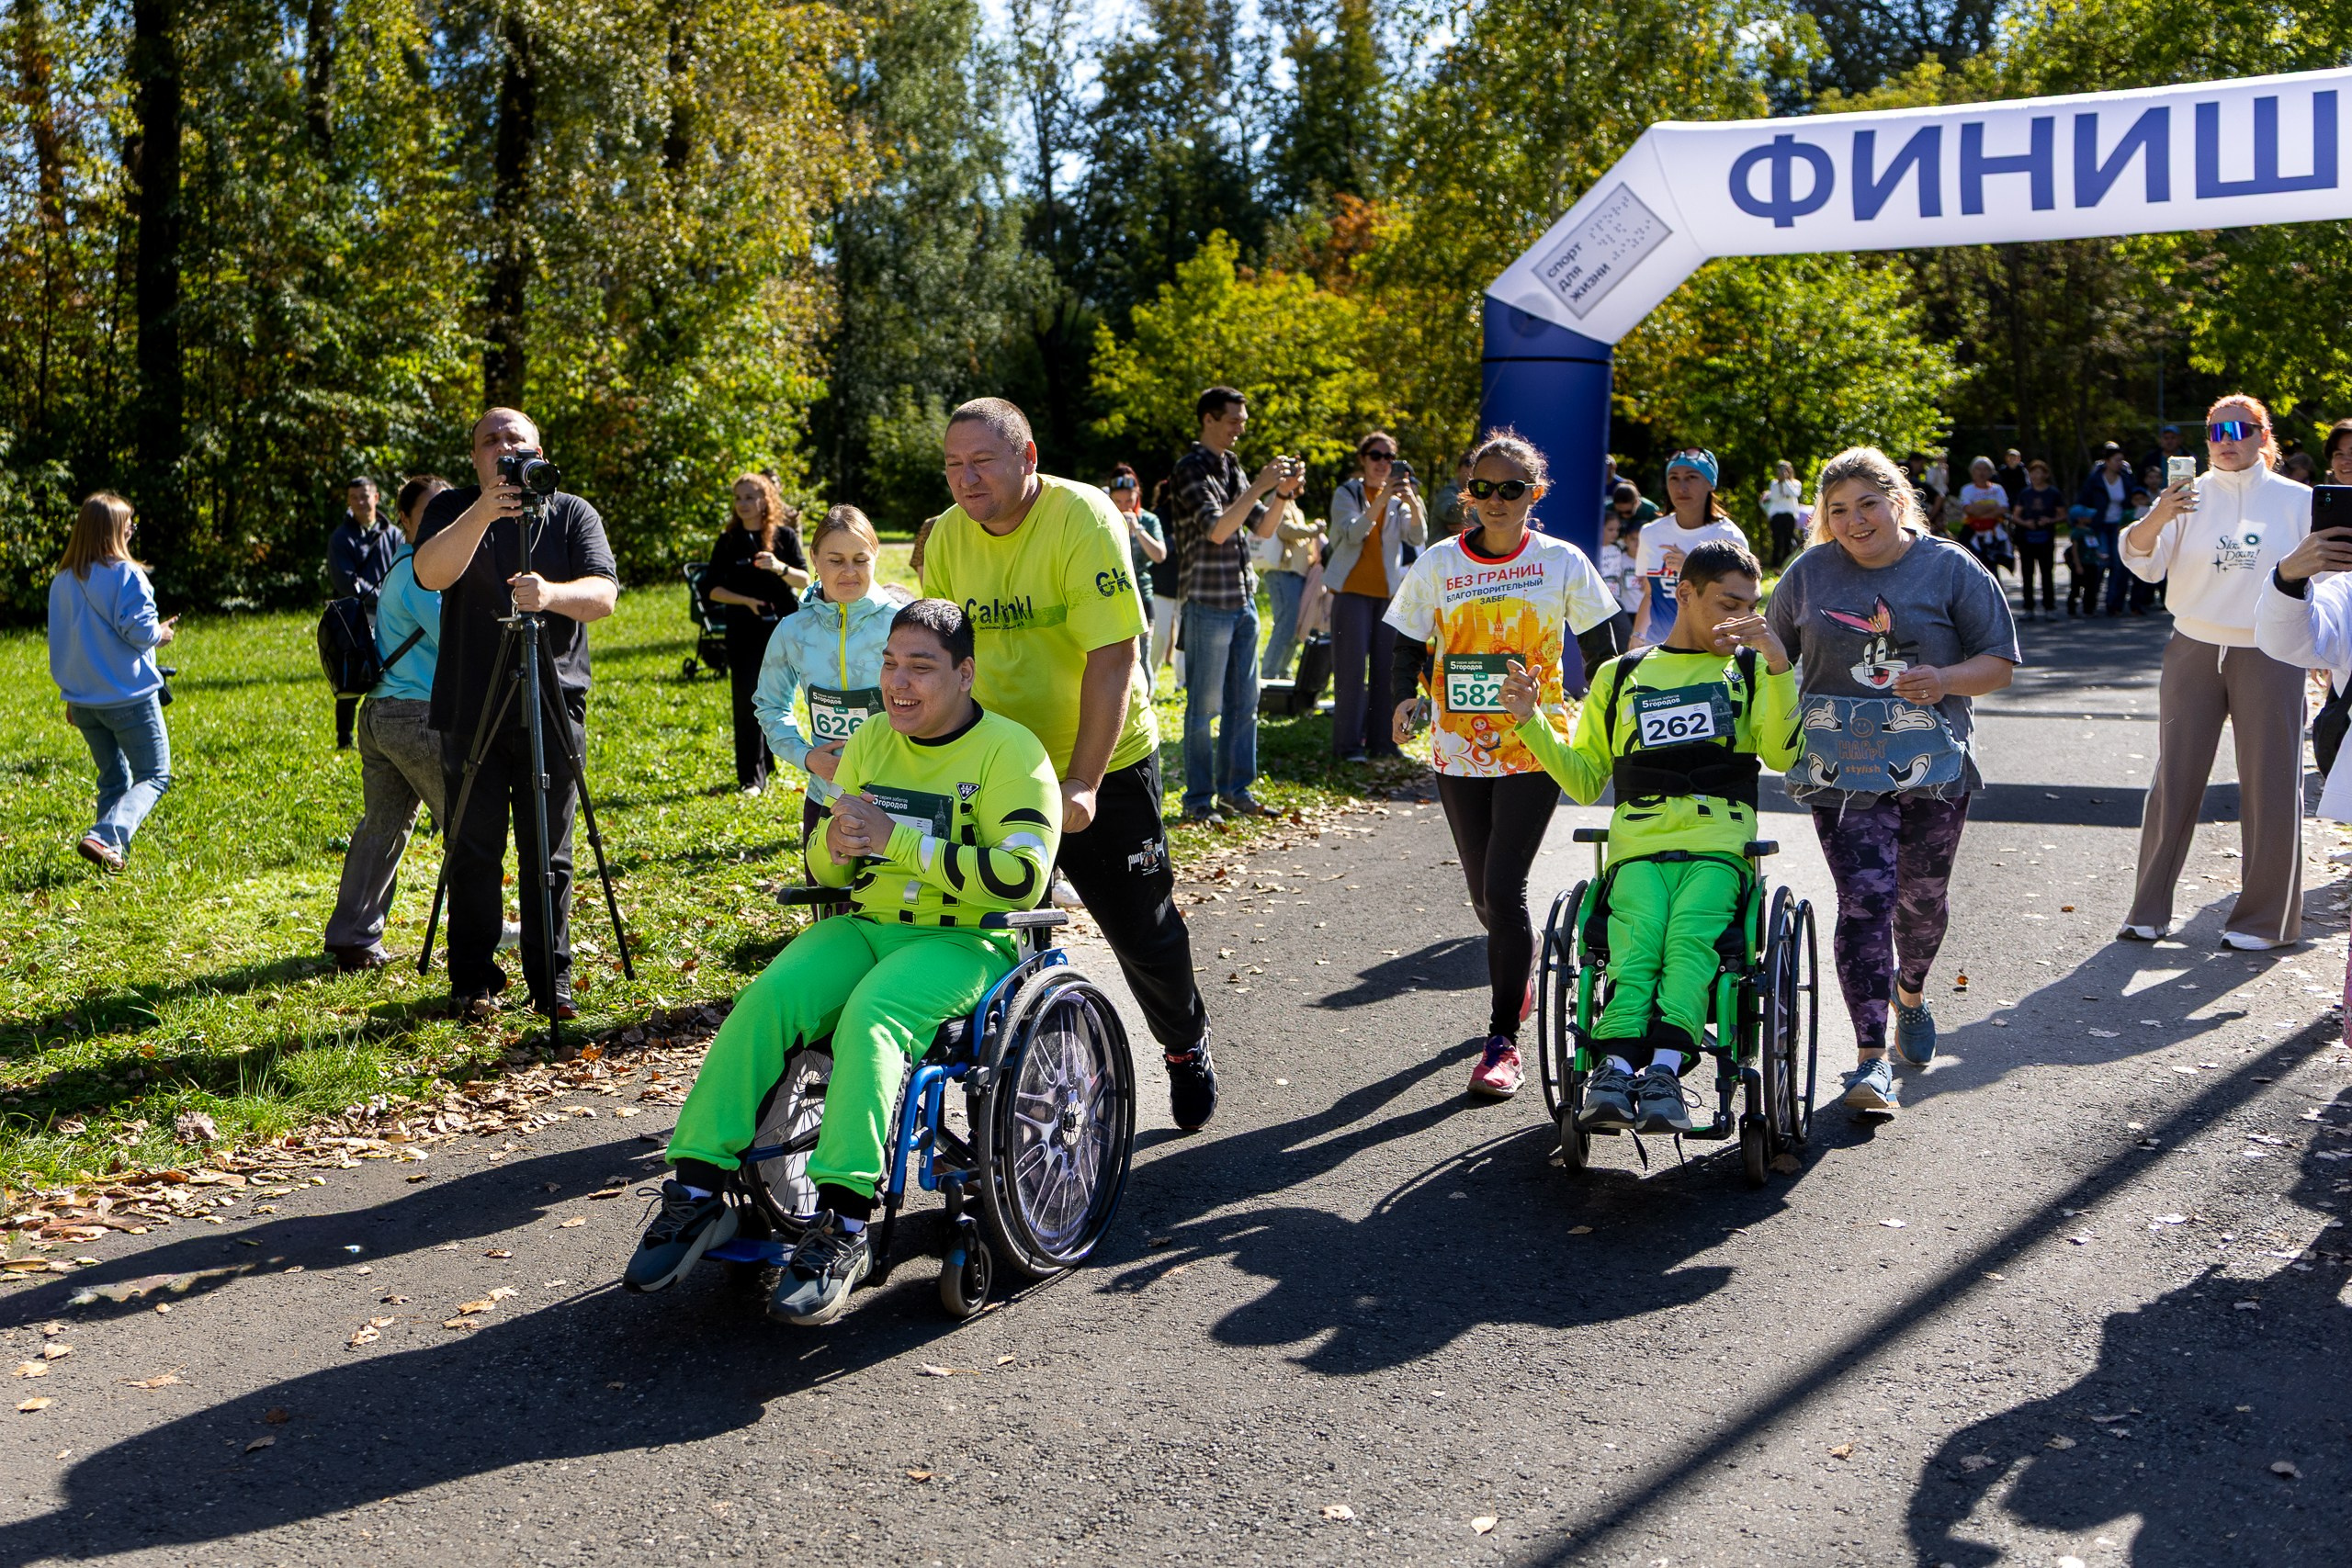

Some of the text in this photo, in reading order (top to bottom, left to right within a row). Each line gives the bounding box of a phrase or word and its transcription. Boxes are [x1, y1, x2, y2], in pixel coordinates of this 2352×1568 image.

[1728, 89, 2339, 228] ФИНИШ
[1547, 242, 1583, 277] спорт
[1558, 265, 1583, 292] для
[1570, 263, 1611, 303] жизни
[1446, 563, 1544, 591] БЕЗ ГРАНИЦ
[1446, 578, 1544, 603] БЛАГОТВОРИТЕЛЬНЫЙ
[1480, 593, 1508, 605] ЗАБЕГ
[1450, 661, 1455, 670] 5
[1453, 683, 1502, 706] 582
[1642, 698, 1680, 708] 5 городов
[1646, 712, 1709, 741] 262
[1845, 764, 1881, 775] stylish
[878, 800, 908, 810] городов
[892, 795, 909, 804] забегов
